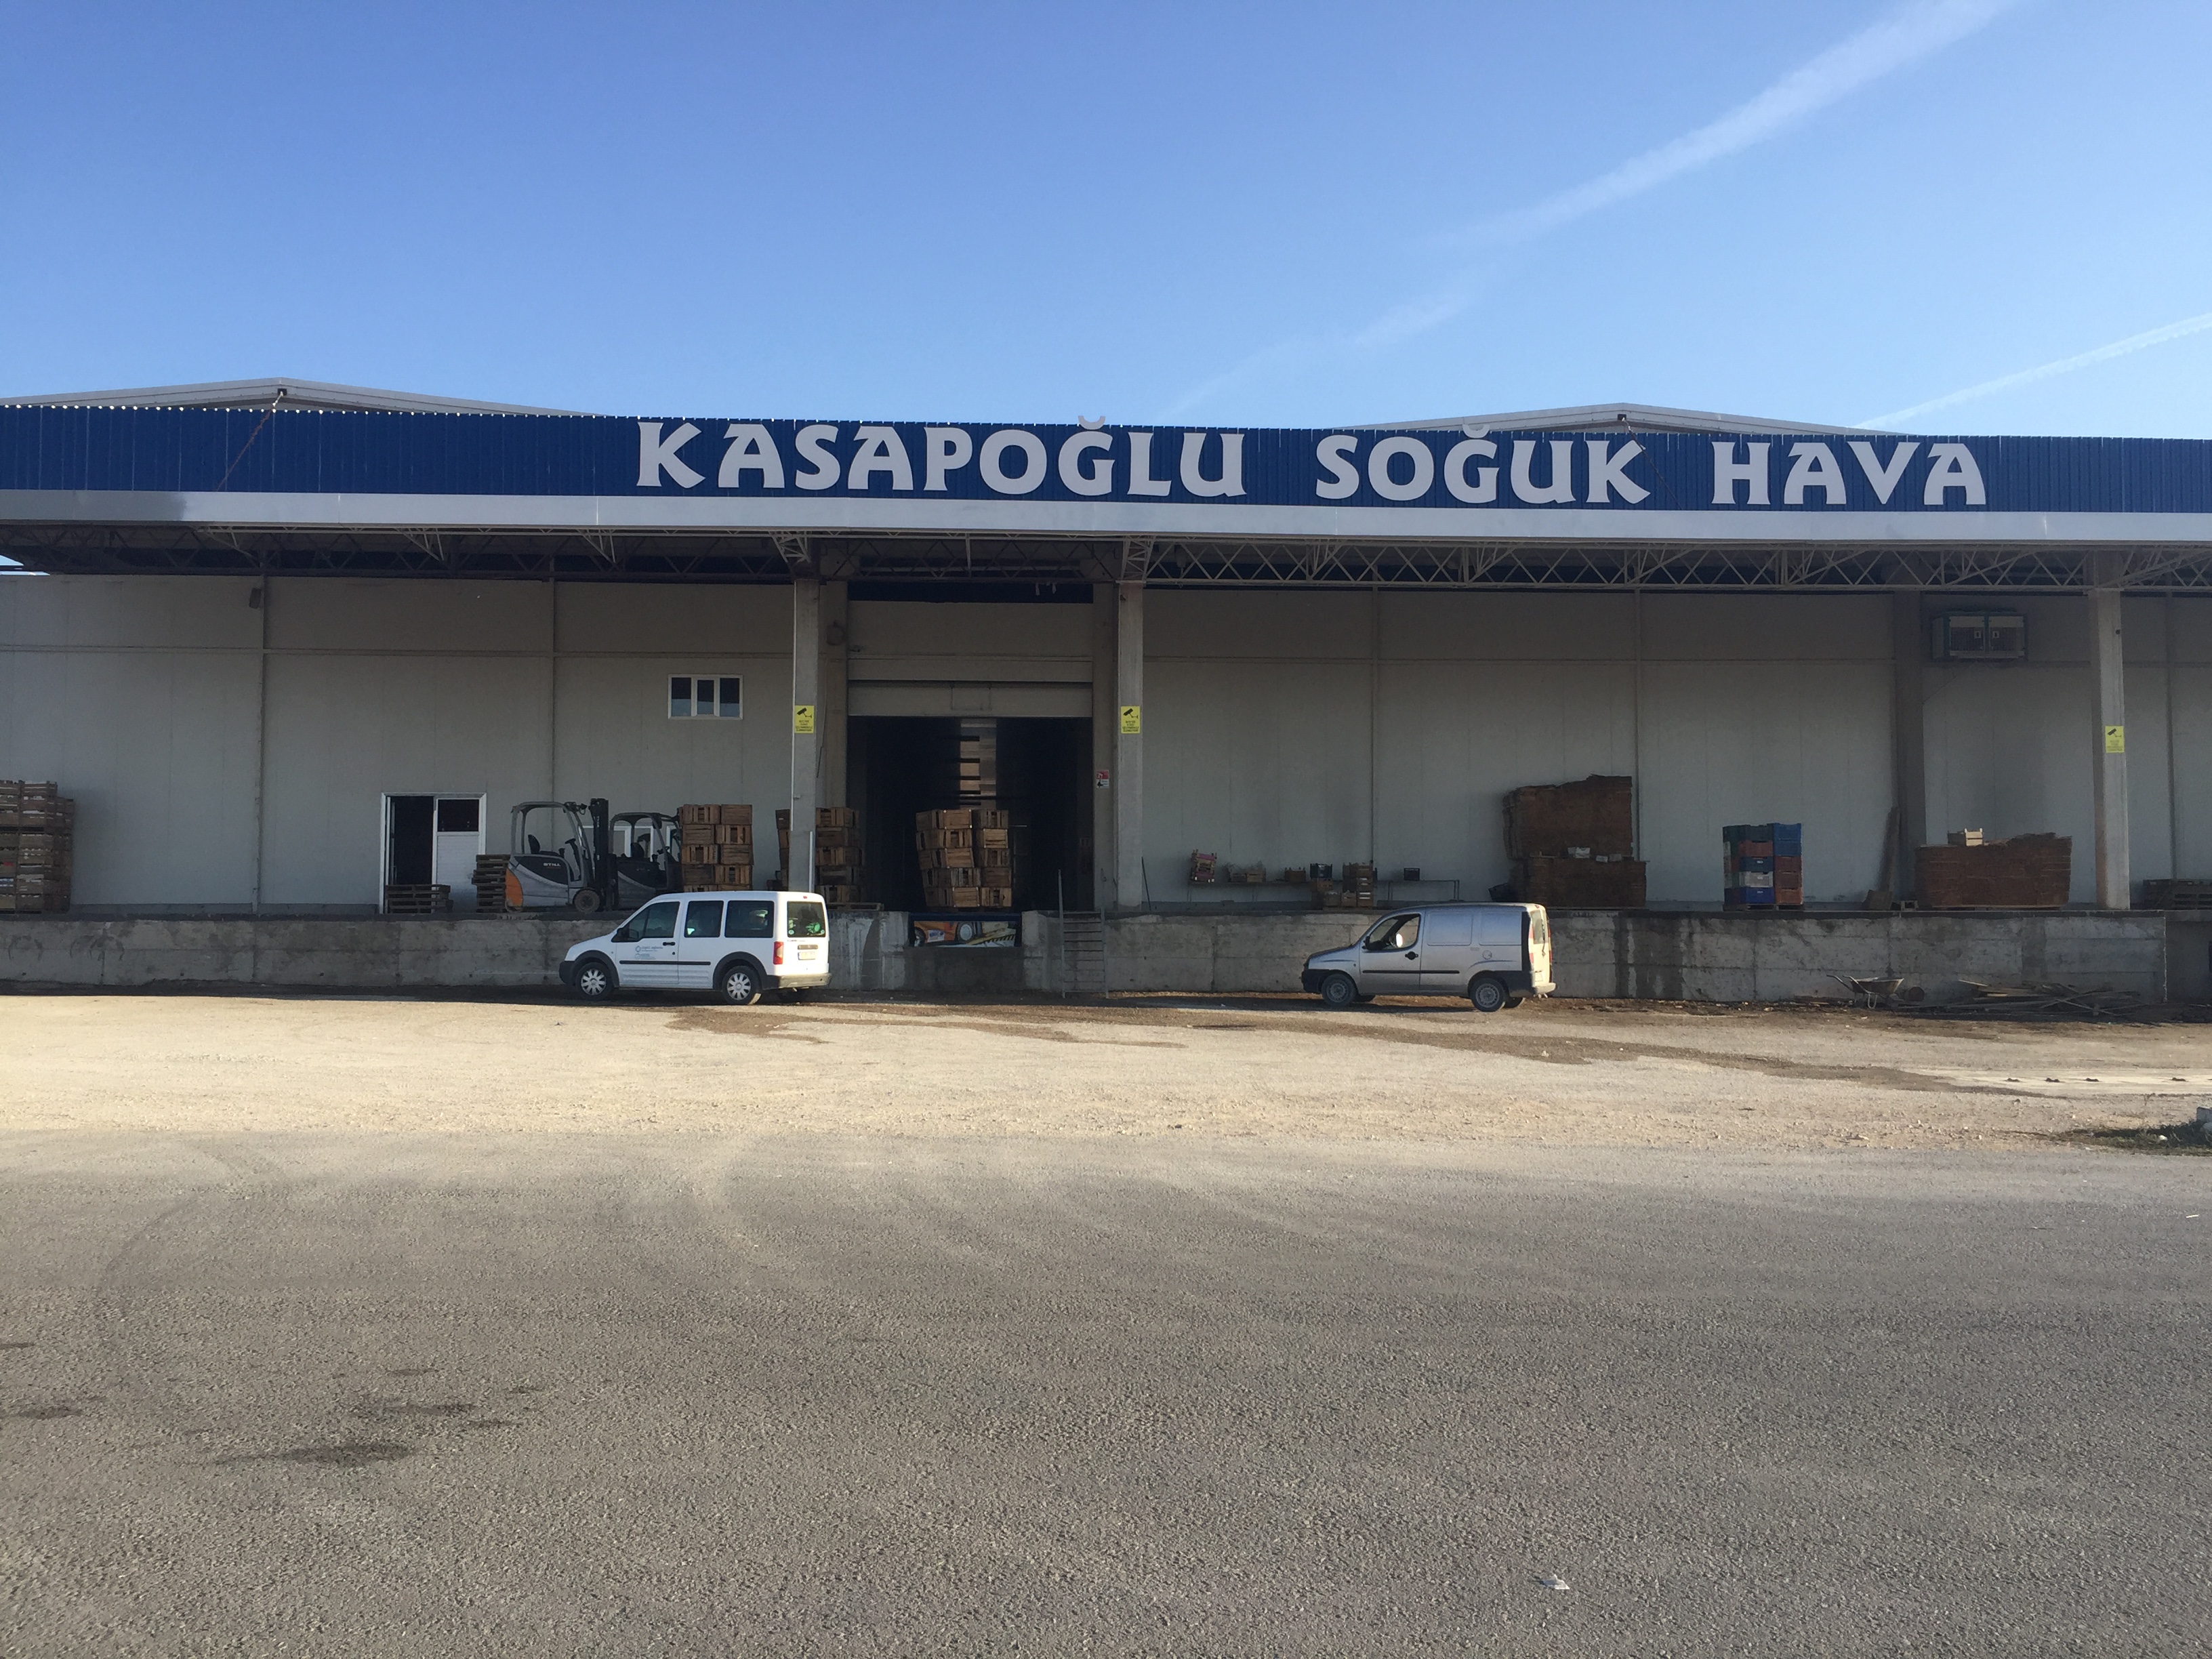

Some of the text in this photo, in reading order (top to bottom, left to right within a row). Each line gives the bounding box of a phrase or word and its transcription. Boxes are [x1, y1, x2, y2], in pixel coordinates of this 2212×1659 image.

[636, 415, 1987, 506] KASAPOĞLU SOĞUK HAVA
